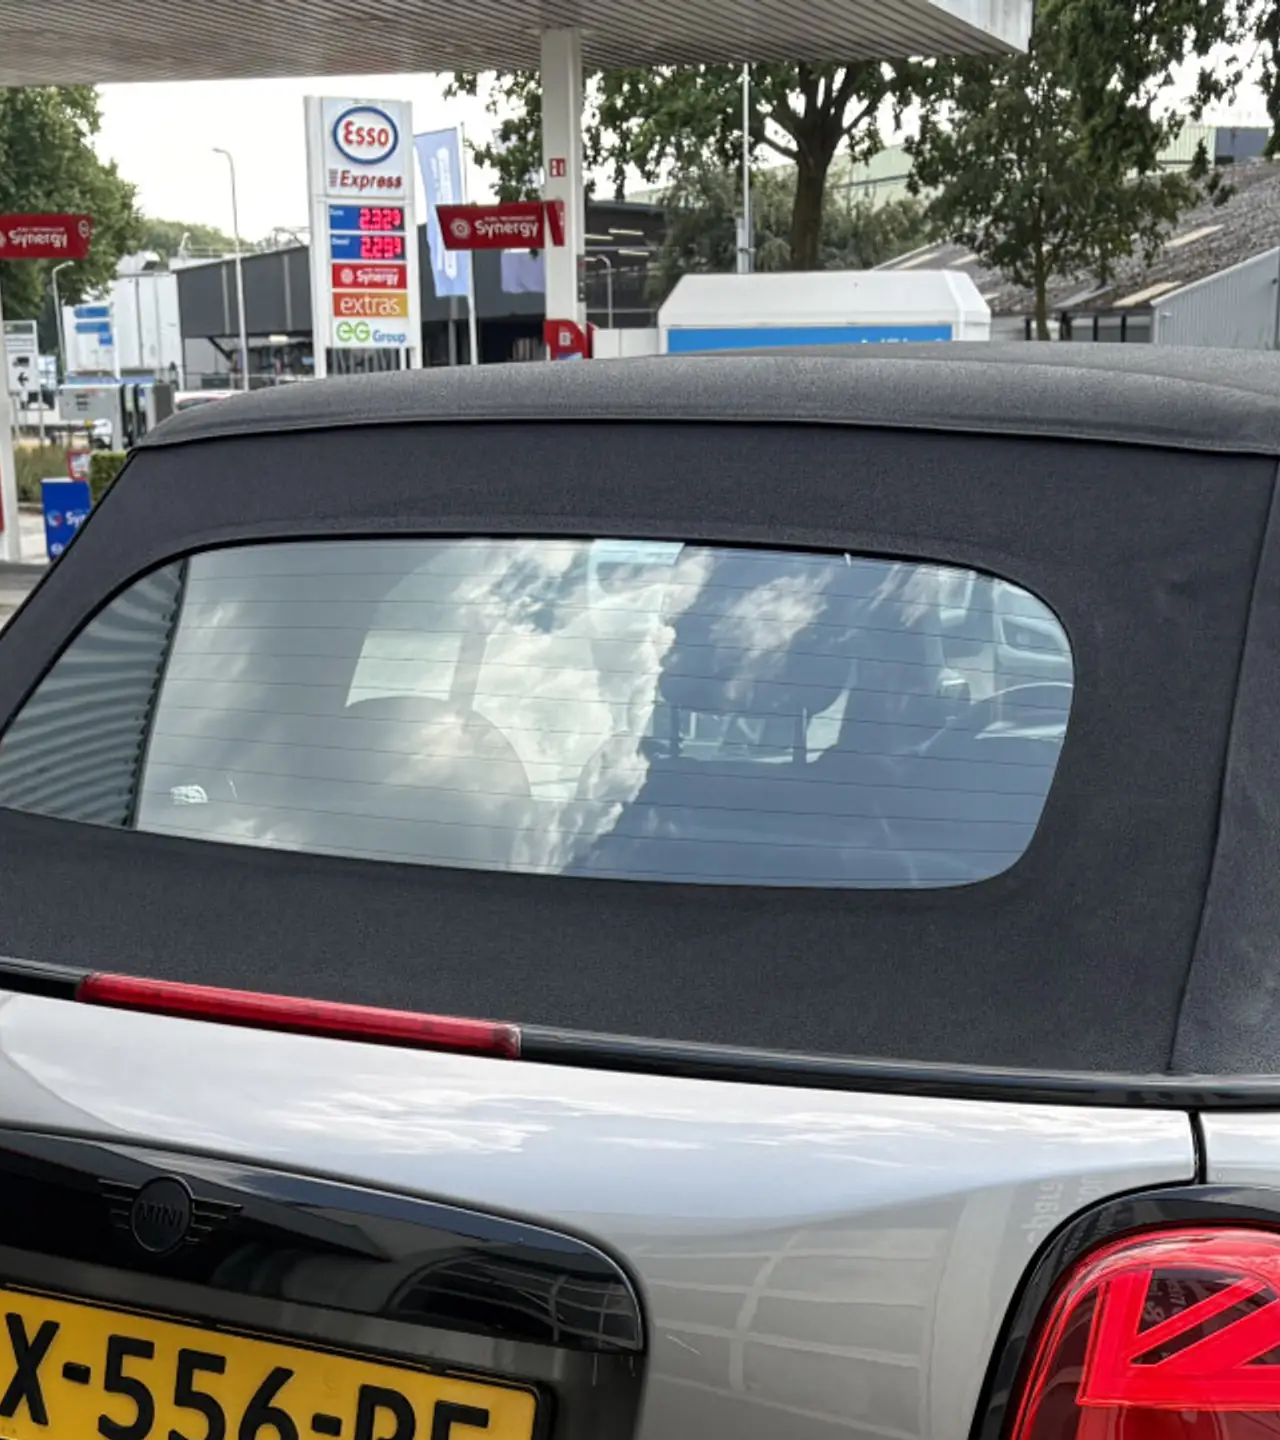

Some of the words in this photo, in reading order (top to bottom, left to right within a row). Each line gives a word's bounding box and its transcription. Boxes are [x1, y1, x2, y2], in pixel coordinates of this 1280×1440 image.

[343, 120, 390, 147] Esso
[340, 169, 402, 192] Express
[8, 229, 68, 249] Synergy
[473, 219, 539, 240] Synergy
[355, 269, 400, 287] Synergy
[339, 294, 401, 315] extras
[371, 329, 407, 347] Group
